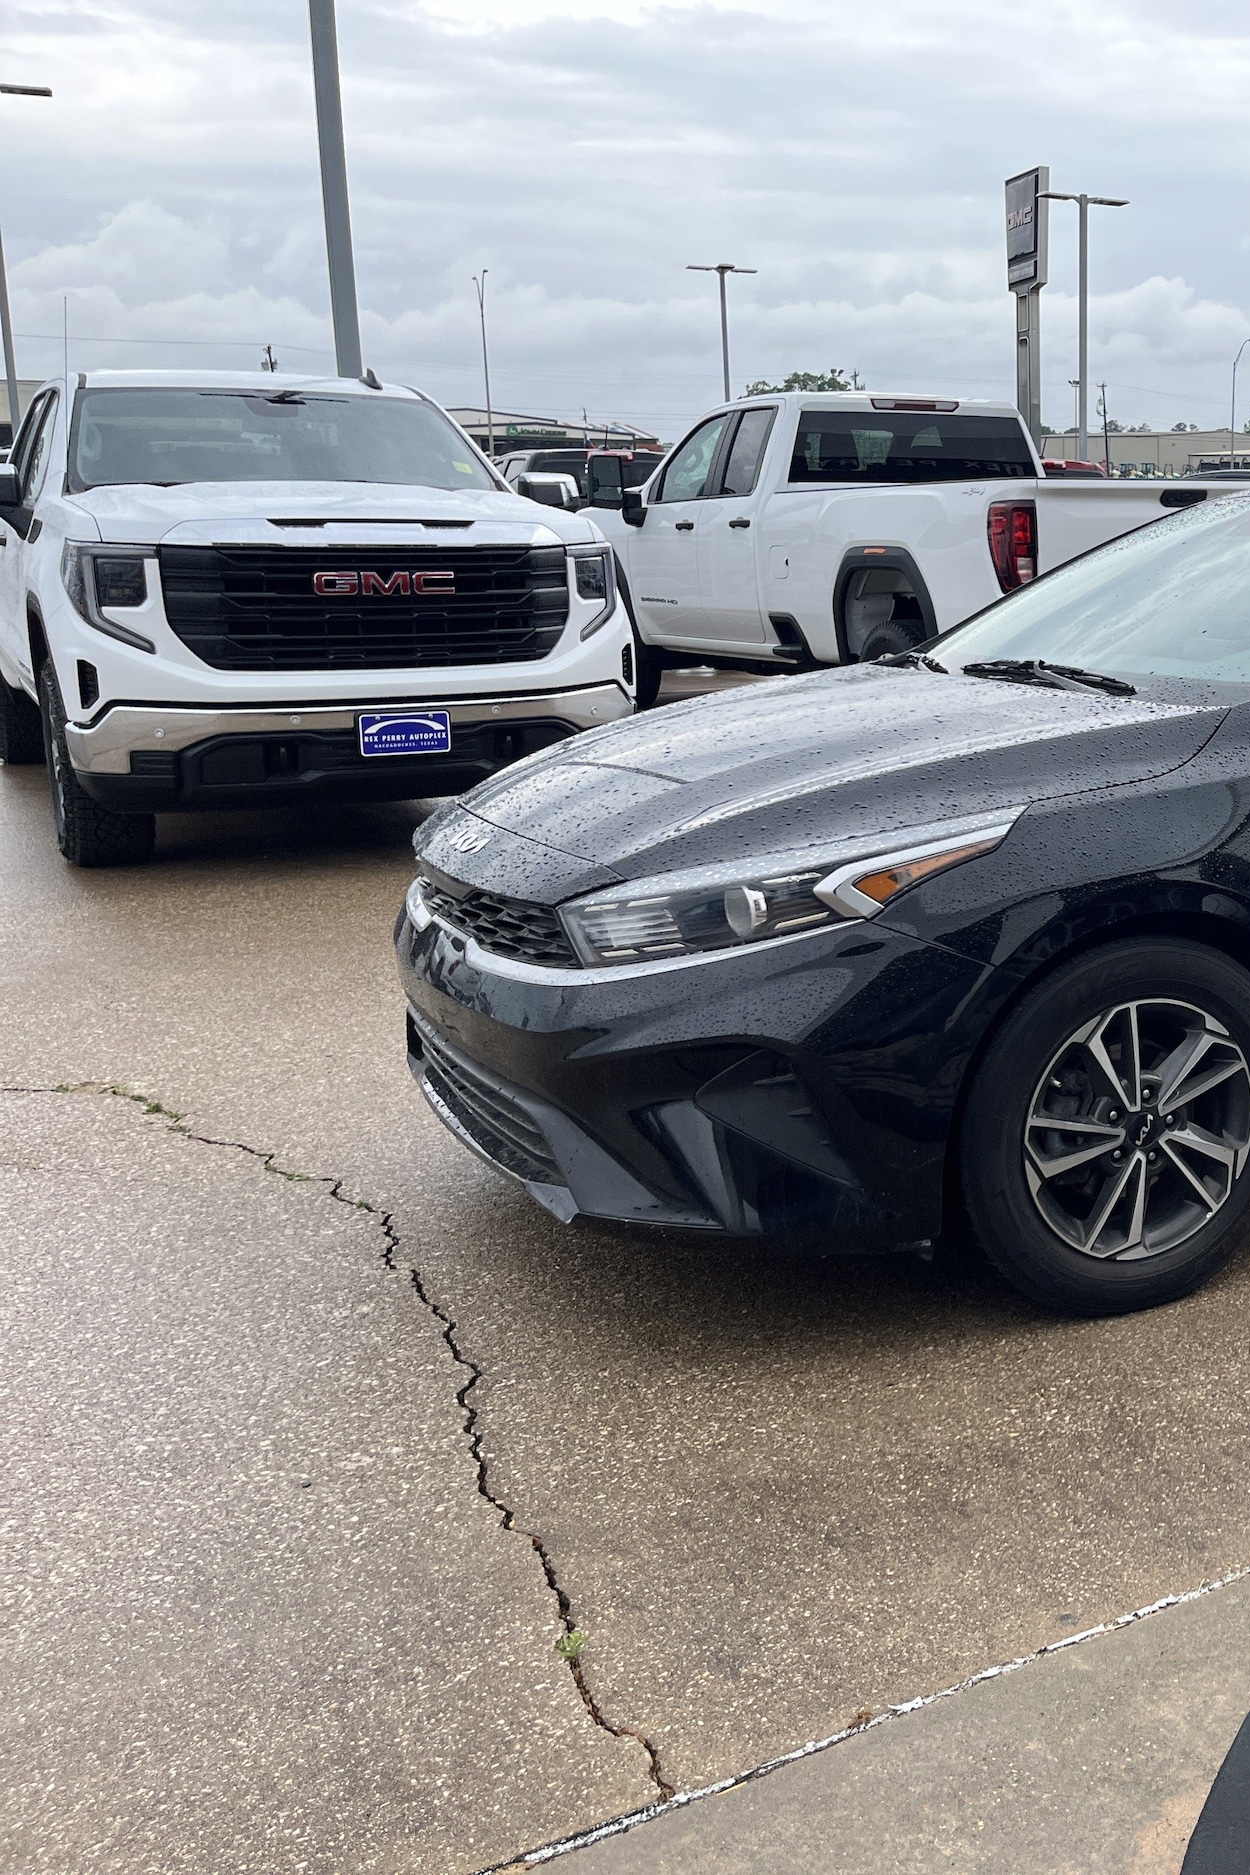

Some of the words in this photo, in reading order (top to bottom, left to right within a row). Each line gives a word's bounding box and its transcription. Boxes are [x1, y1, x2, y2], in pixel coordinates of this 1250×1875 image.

[1008, 206, 1032, 231] GMC
[313, 571, 456, 596] GMC
[364, 735, 379, 743] REX
[382, 734, 406, 742] PERRY
[409, 732, 446, 741] AUTOPLEX
